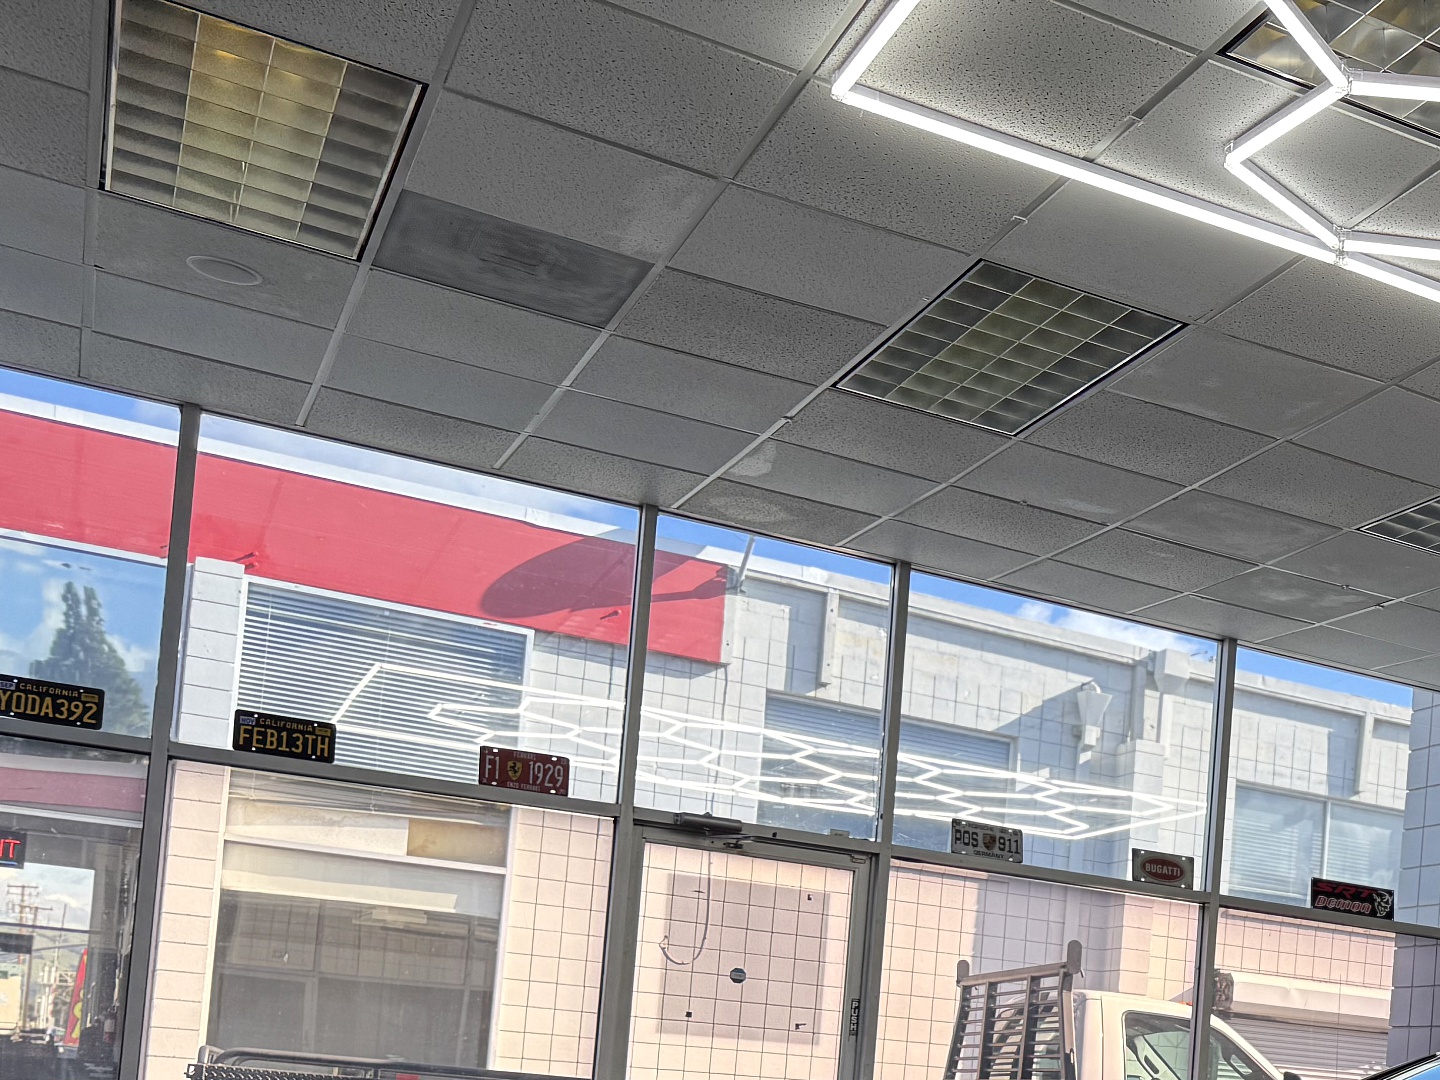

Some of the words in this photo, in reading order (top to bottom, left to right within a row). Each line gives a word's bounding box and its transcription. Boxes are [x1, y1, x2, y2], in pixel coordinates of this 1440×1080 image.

[20, 683, 79, 697] CALIFORNIA
[0, 689, 98, 724] YODA392
[259, 718, 313, 732] CALIFORNIA
[238, 725, 330, 758] FEB13TH
[485, 755, 500, 780] F1
[528, 761, 564, 788] 1929
[954, 829, 979, 848] POS
[998, 836, 1020, 855] 911
[1145, 862, 1181, 877] BUGATTI
[1313, 882, 1377, 899] SRT
[850, 1001, 859, 1031] PUSH
